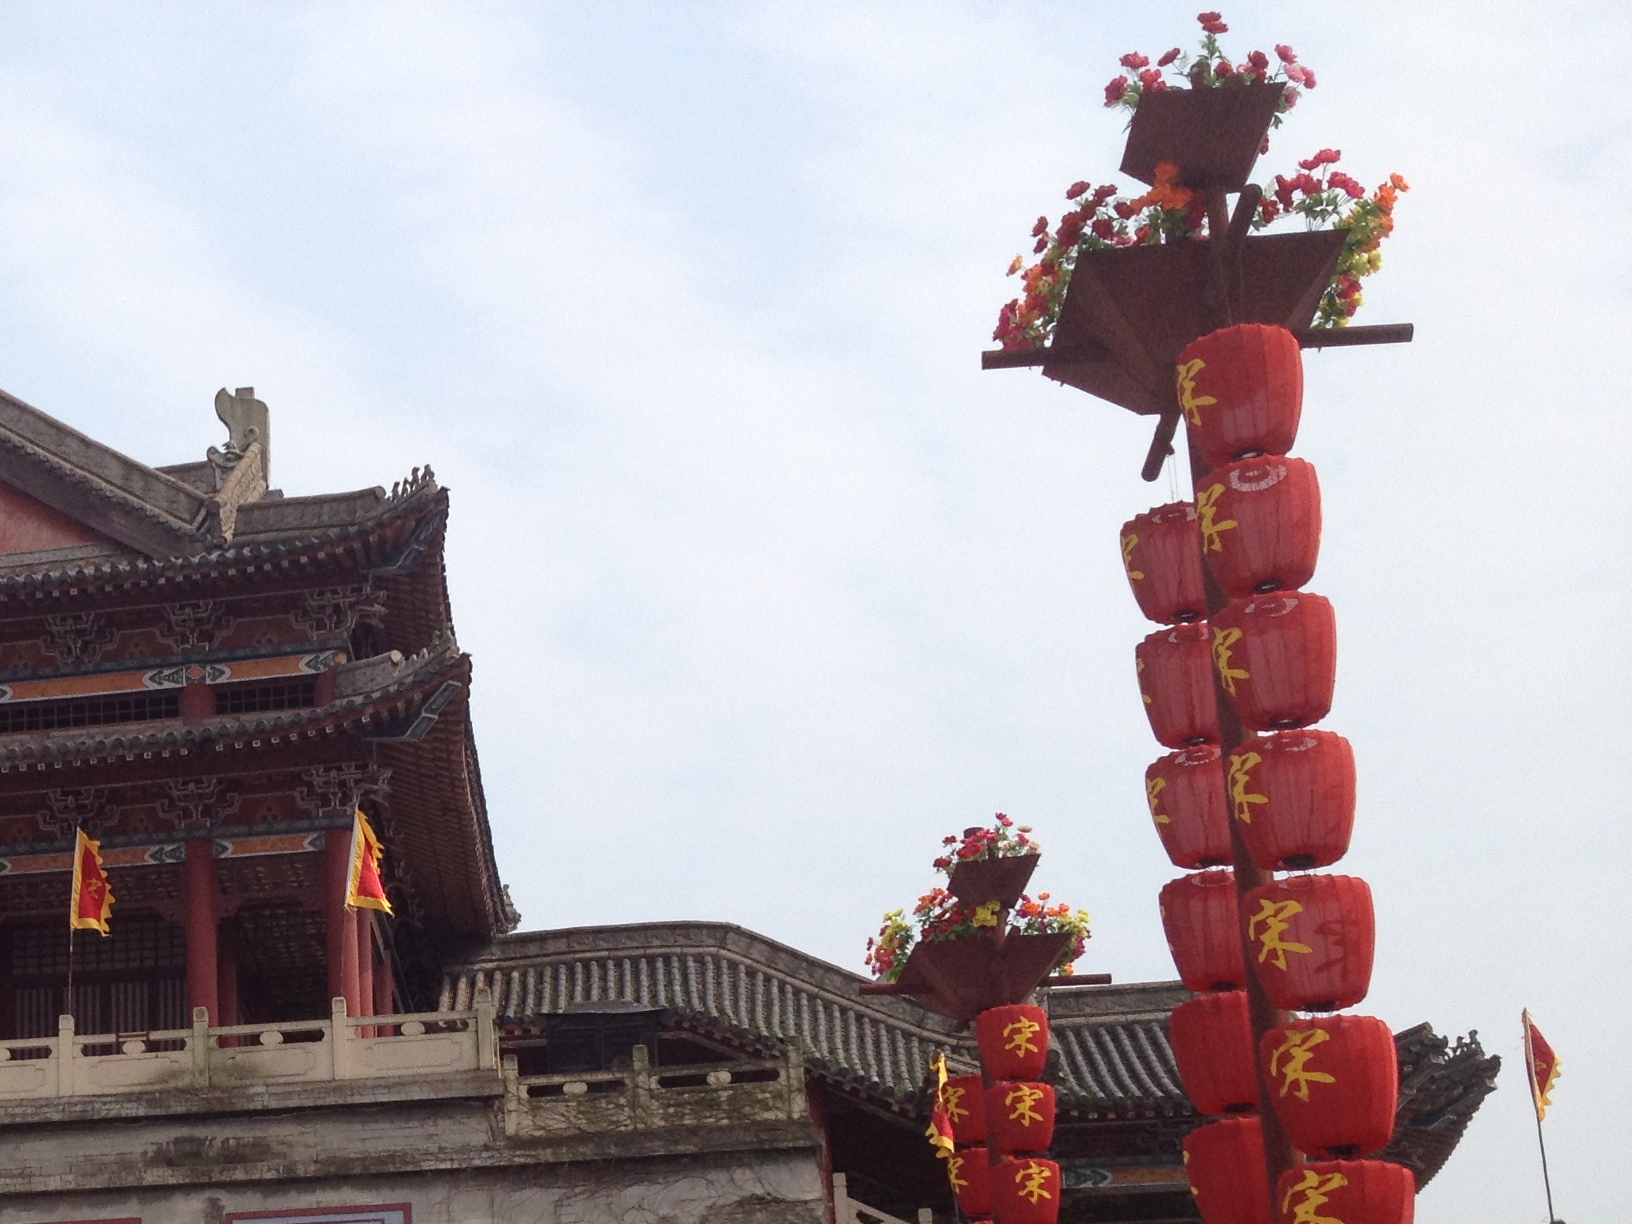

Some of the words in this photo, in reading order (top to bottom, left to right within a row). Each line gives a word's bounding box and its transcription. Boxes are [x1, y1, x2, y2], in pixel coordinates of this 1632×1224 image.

[1247, 897, 1312, 970] 宋
[1003, 1015, 1039, 1057] 宋
[1269, 1027, 1335, 1101] 宋
[1004, 1084, 1043, 1126] 宋
[1014, 1162, 1051, 1204] 宋
